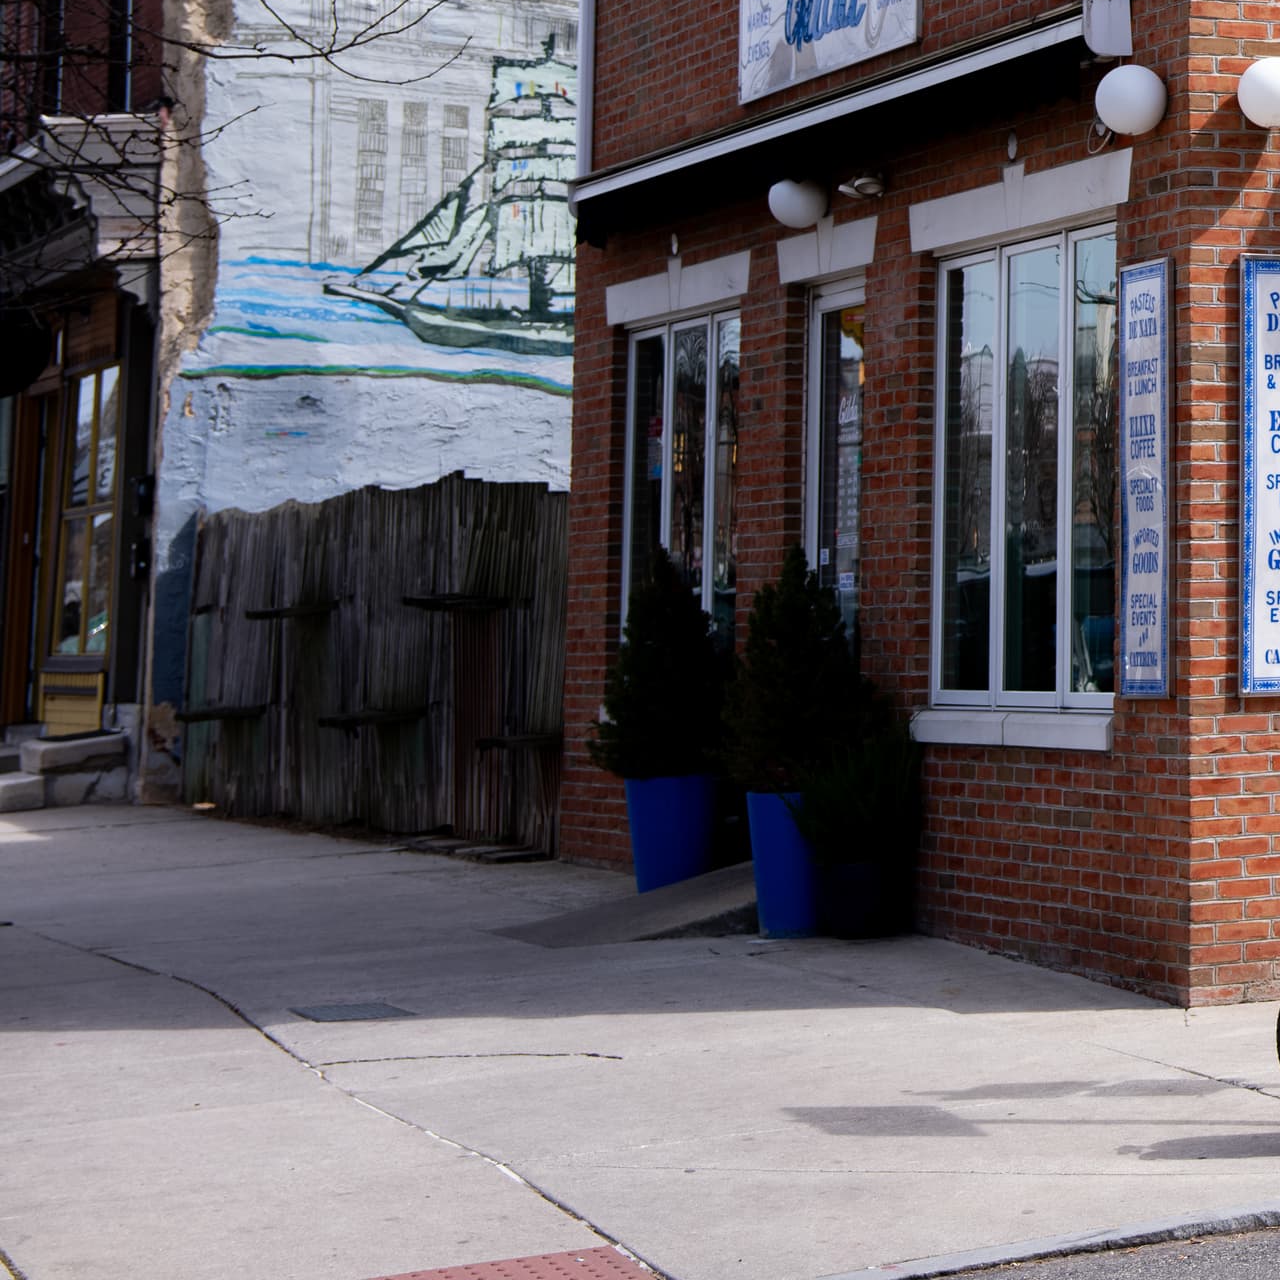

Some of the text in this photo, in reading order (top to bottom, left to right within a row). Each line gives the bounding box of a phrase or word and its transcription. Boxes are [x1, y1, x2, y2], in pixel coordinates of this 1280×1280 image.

[747, 40, 770, 64] EVENTS
[1128, 317, 1157, 340] DE NATA
[1127, 357, 1158, 378] BREAKFAST
[1134, 377, 1157, 396] LUNCH
[1267, 373, 1276, 389] &
[1129, 414, 1156, 438] ELIXR
[1130, 438, 1156, 459] COFFEE
[1129, 477, 1158, 496] SPECIALTY
[1136, 495, 1154, 512] FOODS
[1133, 527, 1159, 549] IMPORTED
[1132, 552, 1159, 574] GOODS
[1130, 593, 1157, 609] SPECIAL
[1132, 610, 1156, 626] EVENTS
[1138, 627, 1149, 648] AND
[1129, 651, 1158, 667] CATERING
